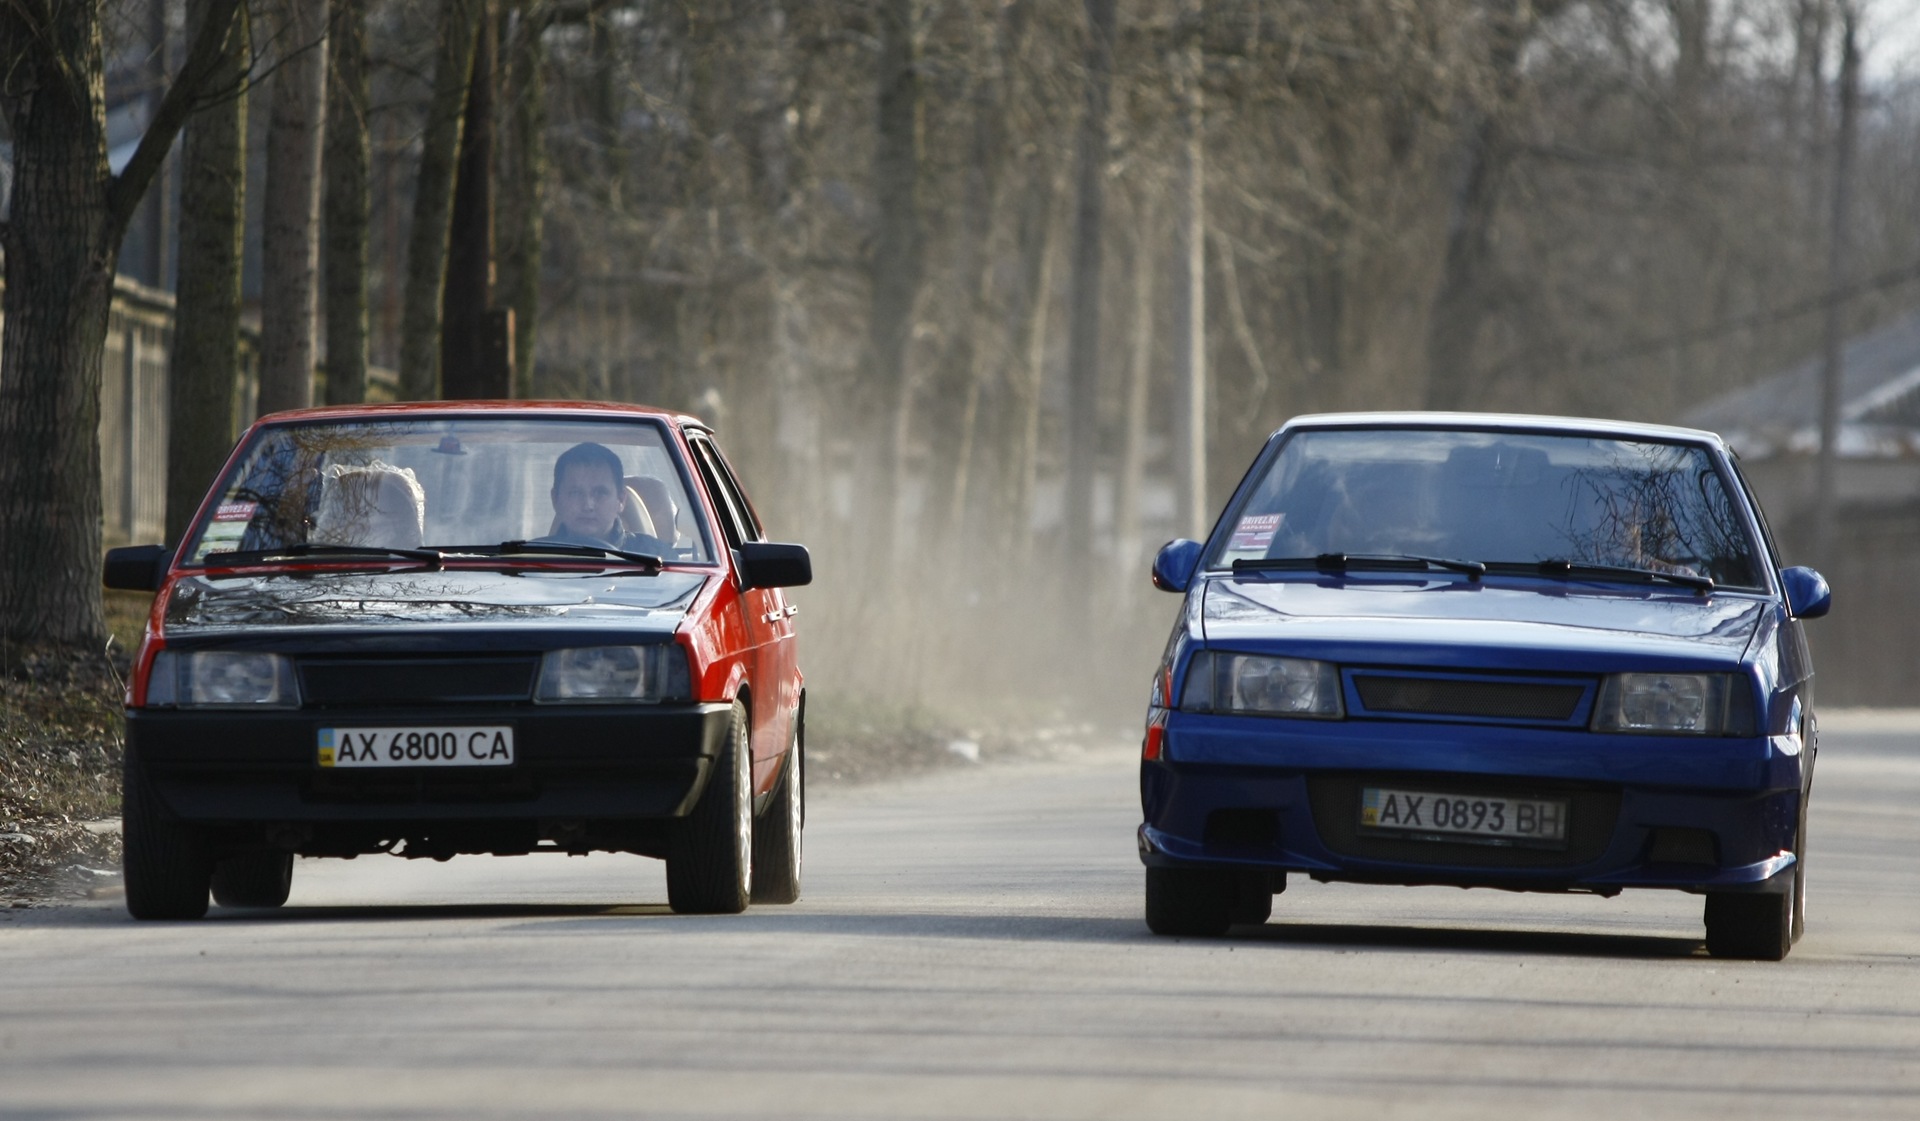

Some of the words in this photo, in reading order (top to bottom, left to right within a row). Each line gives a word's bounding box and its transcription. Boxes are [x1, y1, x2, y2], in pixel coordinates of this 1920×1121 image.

[337, 732, 378, 762] AX
[388, 731, 457, 761] 6800
[467, 731, 510, 760] CA
[1380, 793, 1425, 826] AX
[1432, 798, 1506, 832] 0893
[1516, 803, 1560, 835] BH
